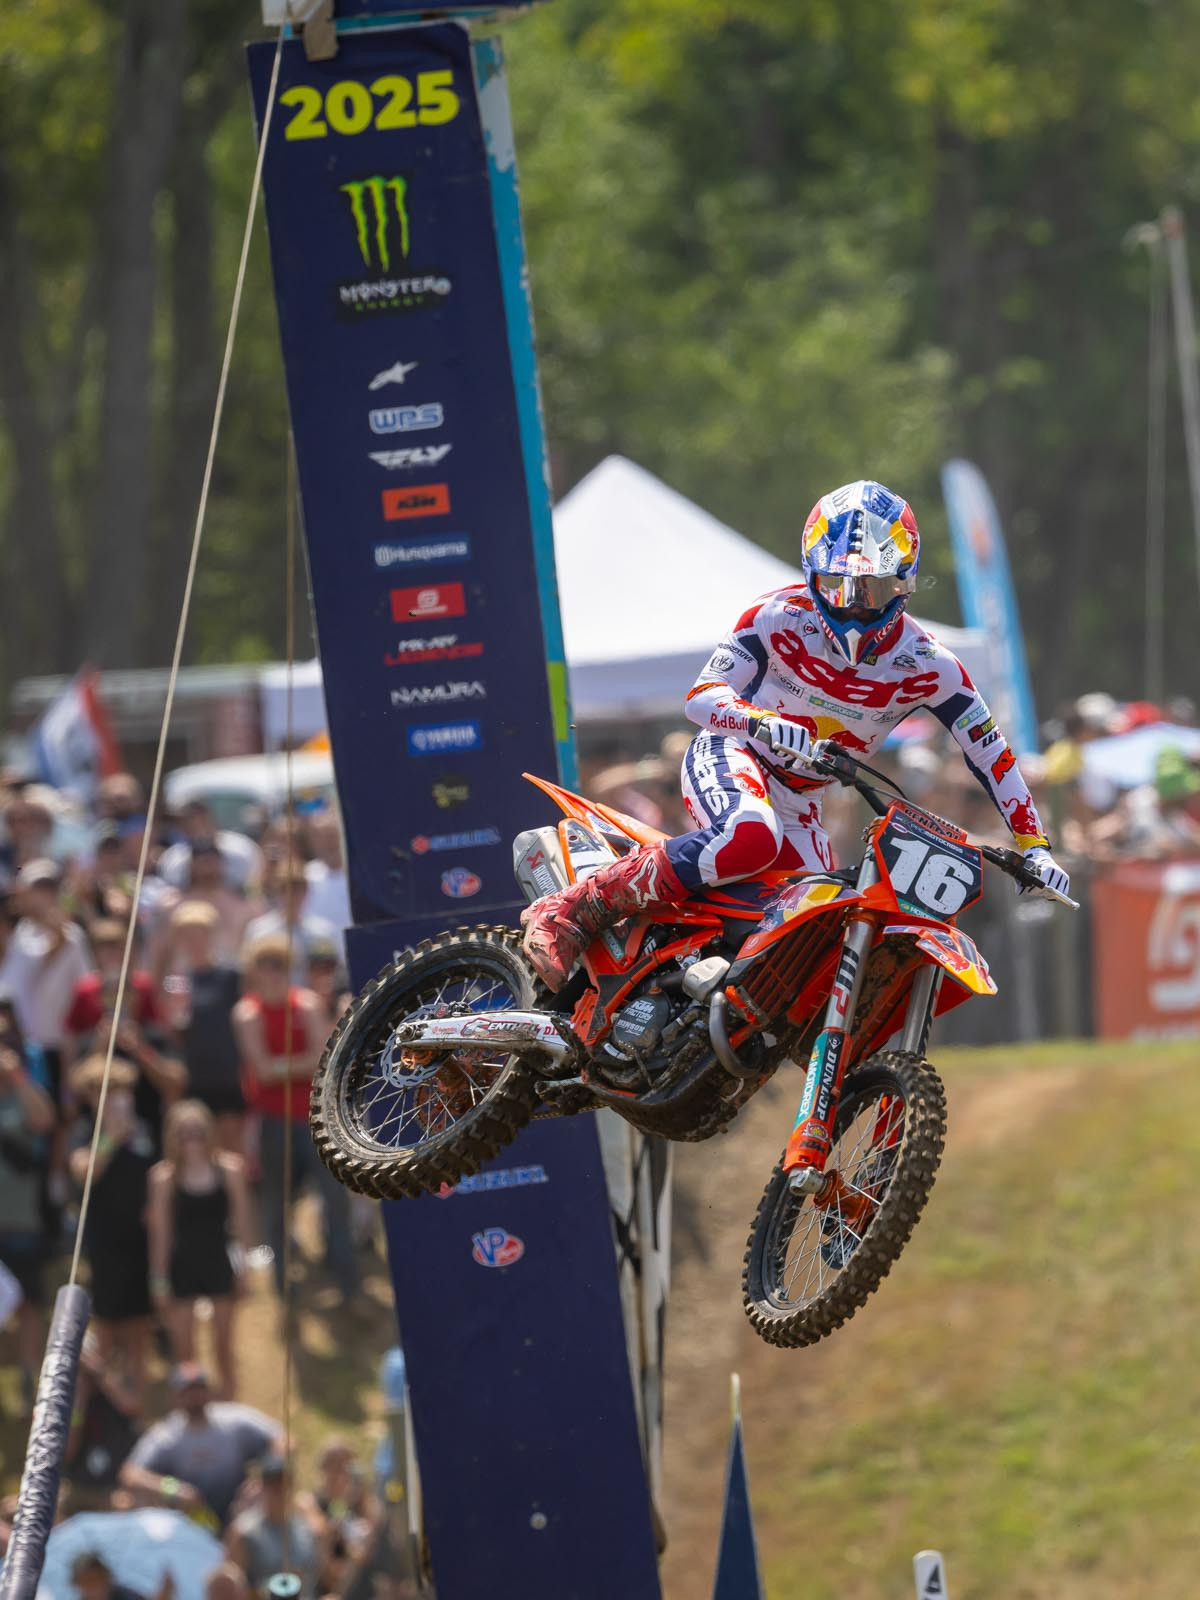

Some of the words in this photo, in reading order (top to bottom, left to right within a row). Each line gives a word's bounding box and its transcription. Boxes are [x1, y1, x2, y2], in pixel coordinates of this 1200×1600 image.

[280, 70, 460, 141] 2025
[370, 404, 442, 432] WPS
[880, 546, 897, 570] AIROH
[771, 628, 940, 708] astars
[391, 681, 486, 706] NAMURA
[710, 712, 727, 728] Red
[728, 715, 749, 731] Bull
[889, 837, 975, 915] 16
[631, 999, 655, 1013] KTM
[799, 1060, 819, 1118] MOTOREX
[818, 1049, 838, 1121] DUNLOP
